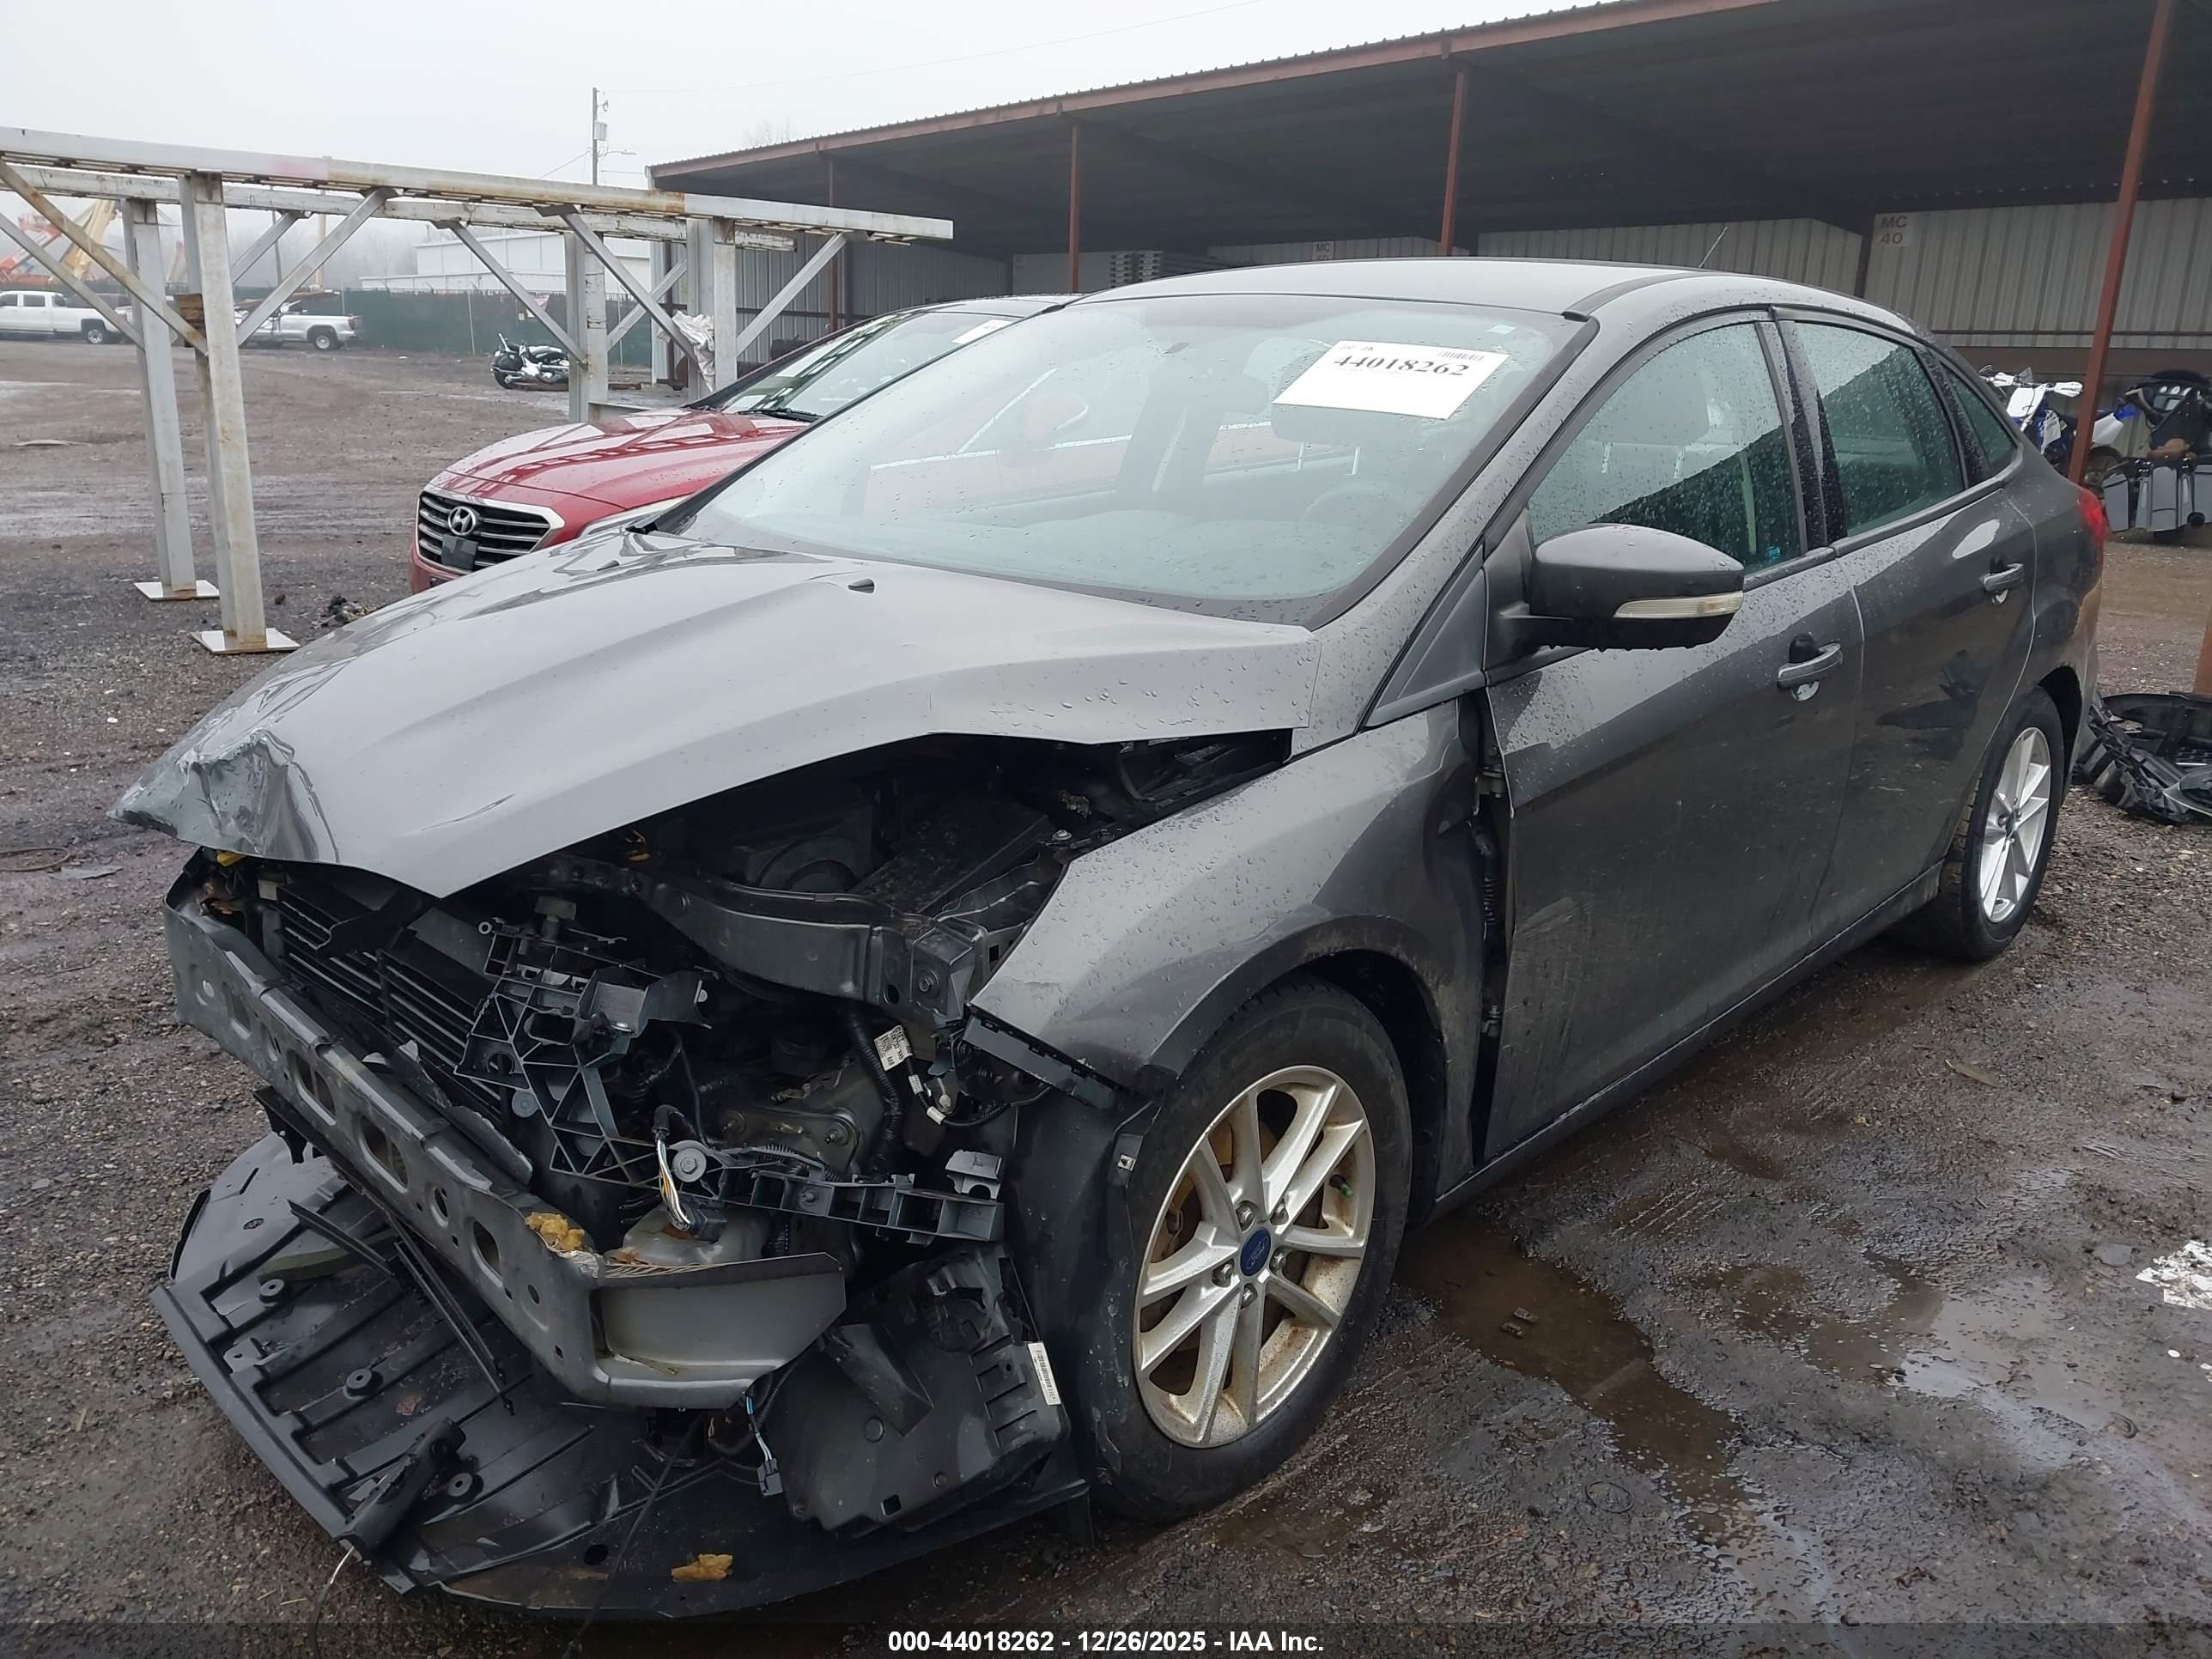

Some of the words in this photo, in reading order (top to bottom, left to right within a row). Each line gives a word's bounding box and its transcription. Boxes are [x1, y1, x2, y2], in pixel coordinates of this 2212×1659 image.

[1881, 216, 1908, 229] MC
[1880, 232, 1904, 246] 40
[1316, 242, 1331, 252] MC
[1334, 355, 1470, 376] 44018262
